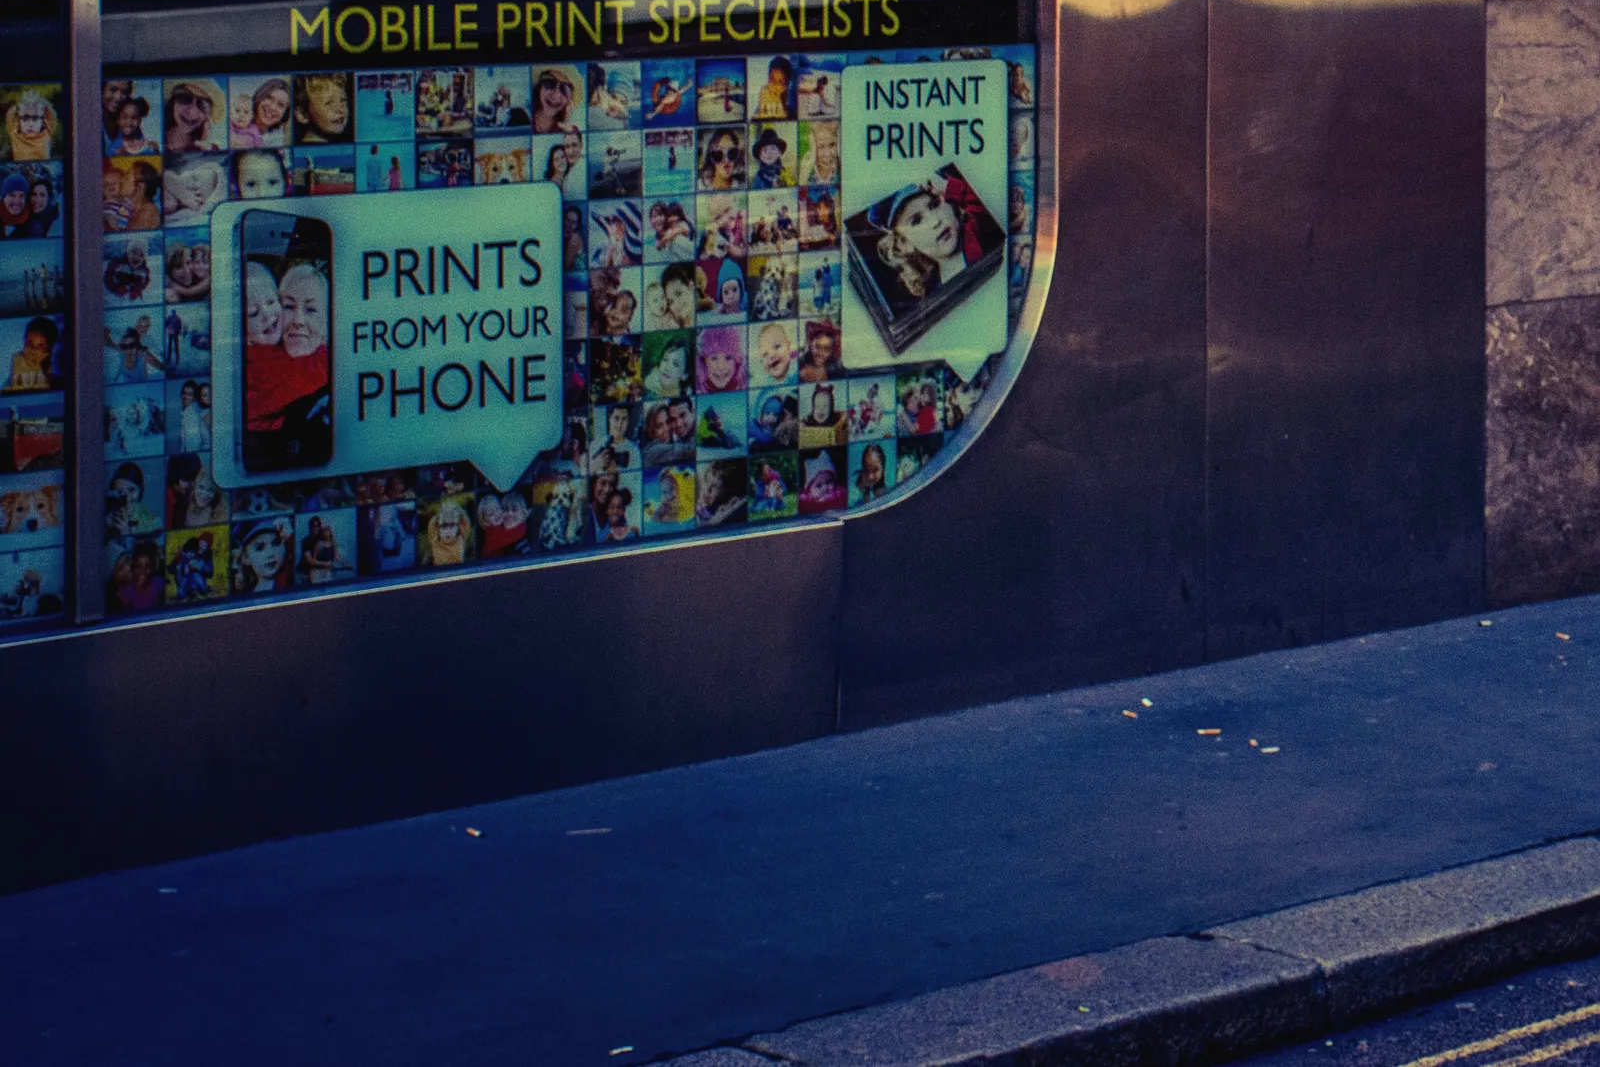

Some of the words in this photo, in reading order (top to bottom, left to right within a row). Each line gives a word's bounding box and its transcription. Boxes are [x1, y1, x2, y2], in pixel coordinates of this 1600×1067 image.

[290, 3, 478, 55] MOBILE
[865, 75, 986, 111] INSTANT
[866, 118, 985, 161] PRINTS
[361, 239, 542, 300] PRINTS
[353, 315, 447, 354] FROM
[457, 306, 552, 343] YOUR
[358, 354, 547, 422] PHONE
